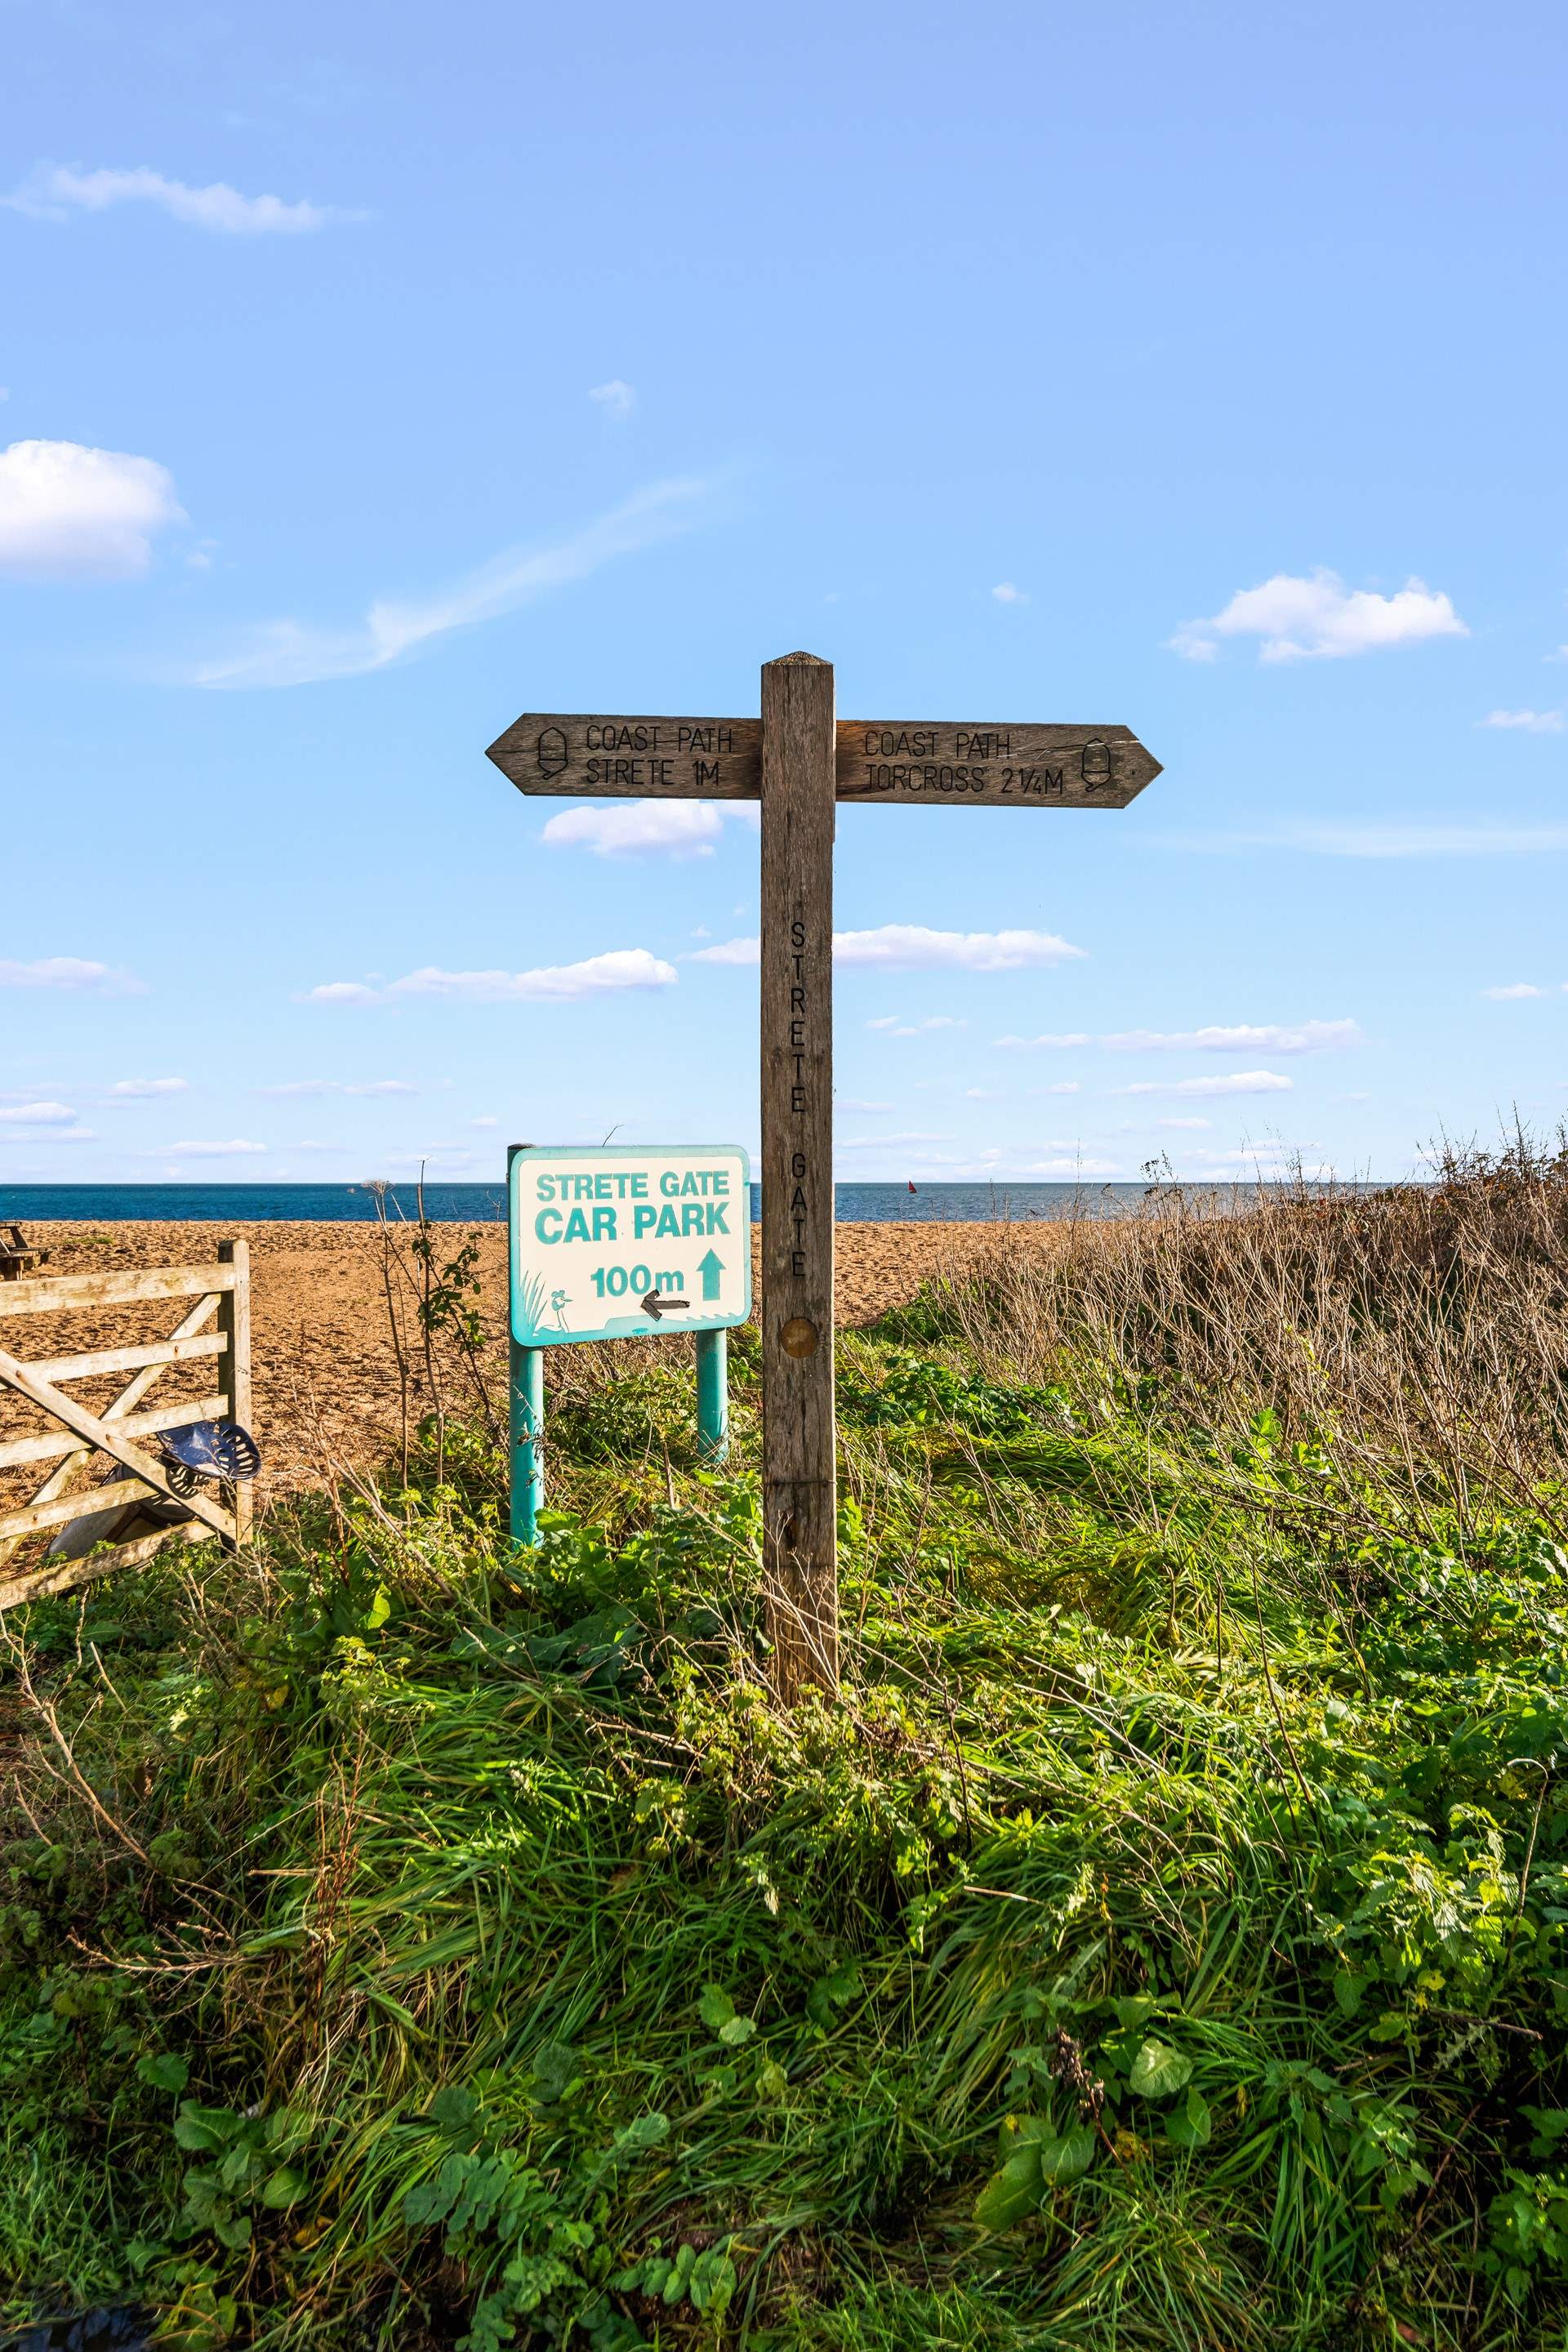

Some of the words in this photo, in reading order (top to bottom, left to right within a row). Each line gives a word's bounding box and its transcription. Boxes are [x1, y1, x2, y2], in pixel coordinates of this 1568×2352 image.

[586, 725, 661, 751] COAST
[678, 727, 733, 753] PATH
[864, 731, 939, 757] COAST
[956, 733, 1010, 760] PATH
[586, 759, 675, 786] STRETE
[693, 760, 719, 786] 1M
[866, 764, 984, 792] TORCROSS
[791, 921, 805, 1112] STRETE
[536, 1172, 648, 1202] STRETE
[659, 1170, 730, 1198] GATE
[535, 1206, 617, 1245] CAR
[633, 1201, 731, 1240] PARK
[791, 1152, 807, 1277] GATE
[590, 1263, 684, 1298] 100m
